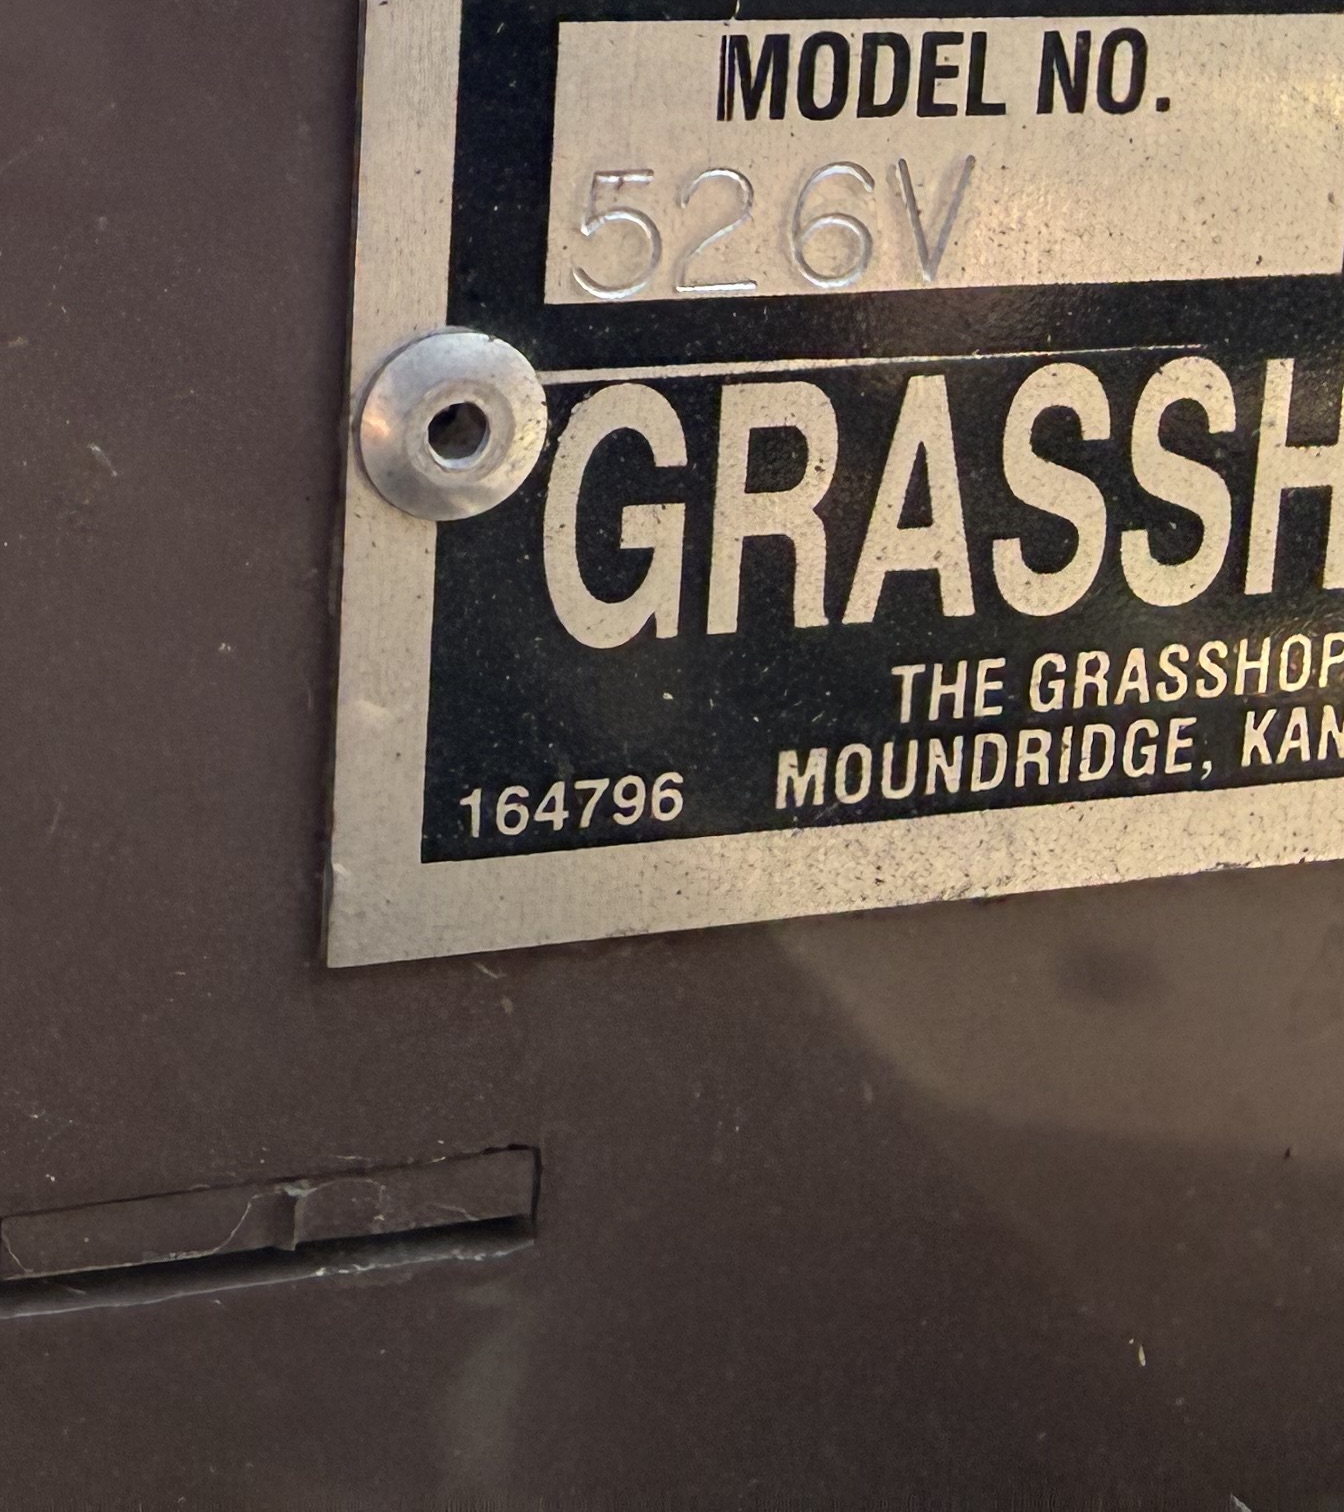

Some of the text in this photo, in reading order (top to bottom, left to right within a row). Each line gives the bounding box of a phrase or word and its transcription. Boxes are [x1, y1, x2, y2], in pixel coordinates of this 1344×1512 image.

[717, 27, 1171, 121] MODEL NO.
[571, 154, 976, 301] 526V
[891, 657, 1007, 725] THE
[459, 771, 685, 839] 164796
[774, 715, 1213, 810] MOUNDRIDGE,
